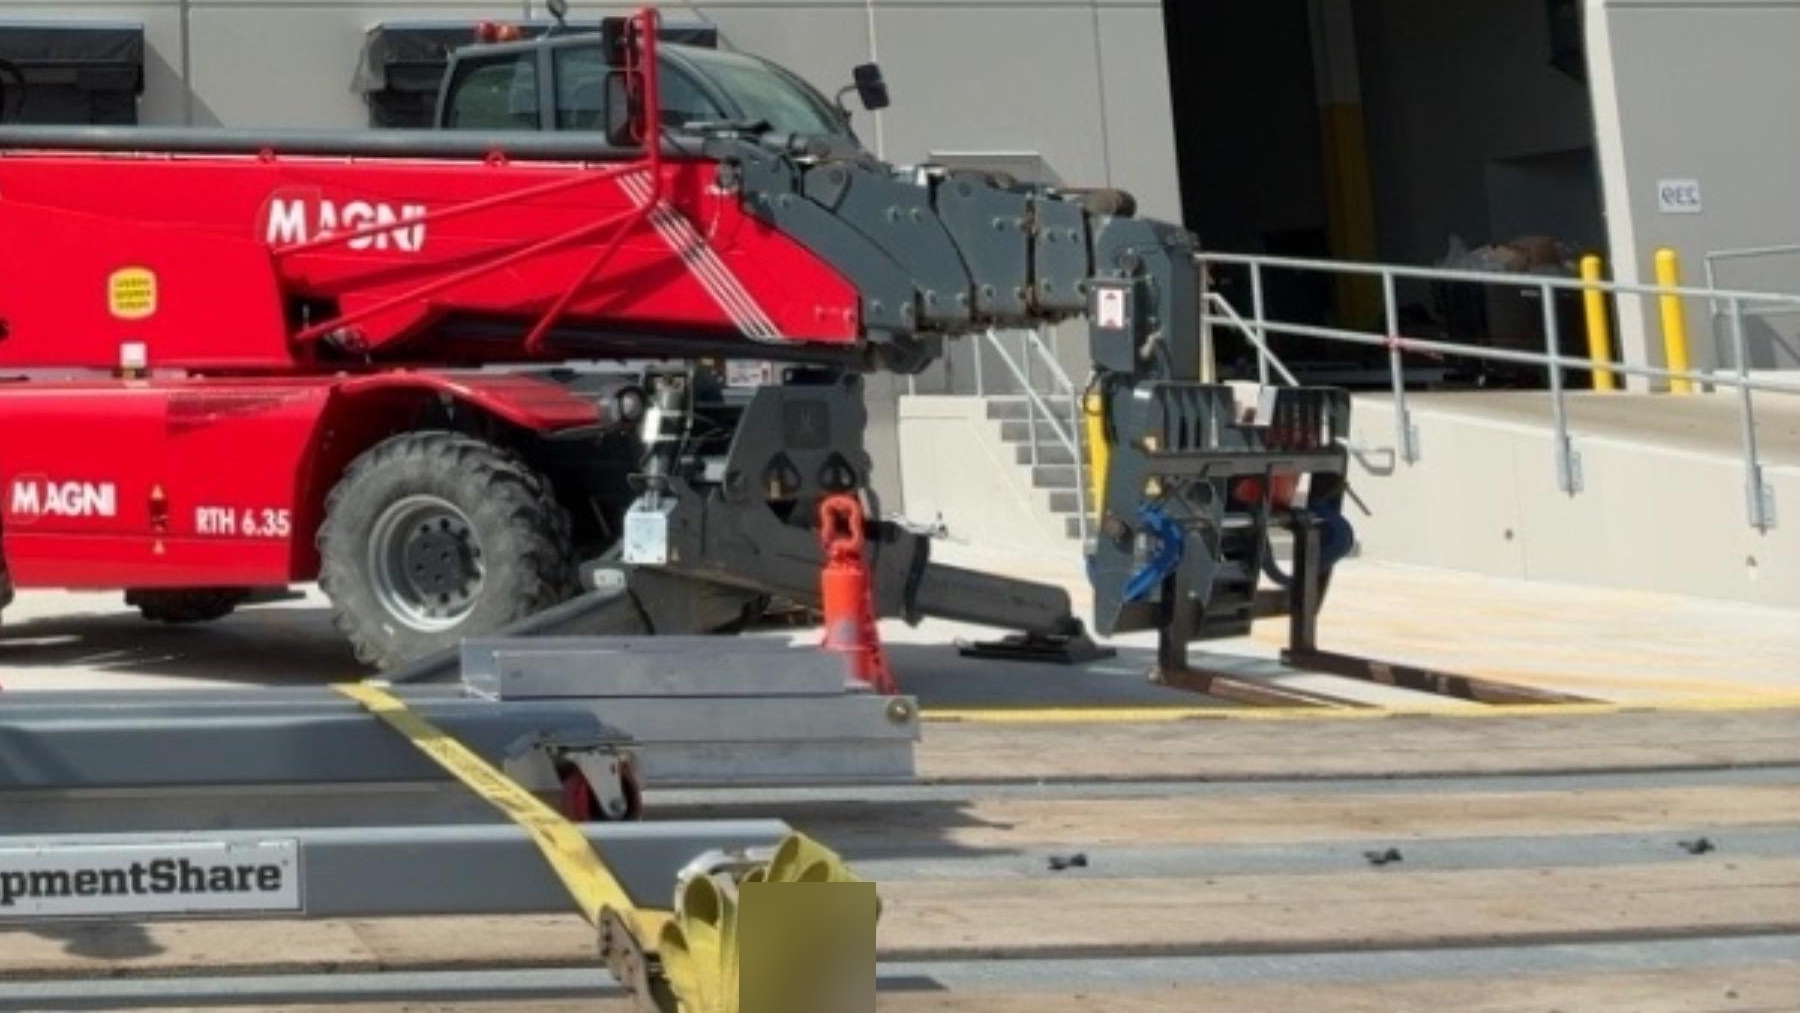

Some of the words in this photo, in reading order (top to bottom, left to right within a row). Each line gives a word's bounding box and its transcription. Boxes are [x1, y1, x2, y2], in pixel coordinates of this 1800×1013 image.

[266, 198, 428, 253] MAGNI
[11, 482, 116, 516] MAGNI
[195, 506, 235, 534] RTH
[241, 508, 291, 537] 6.35
